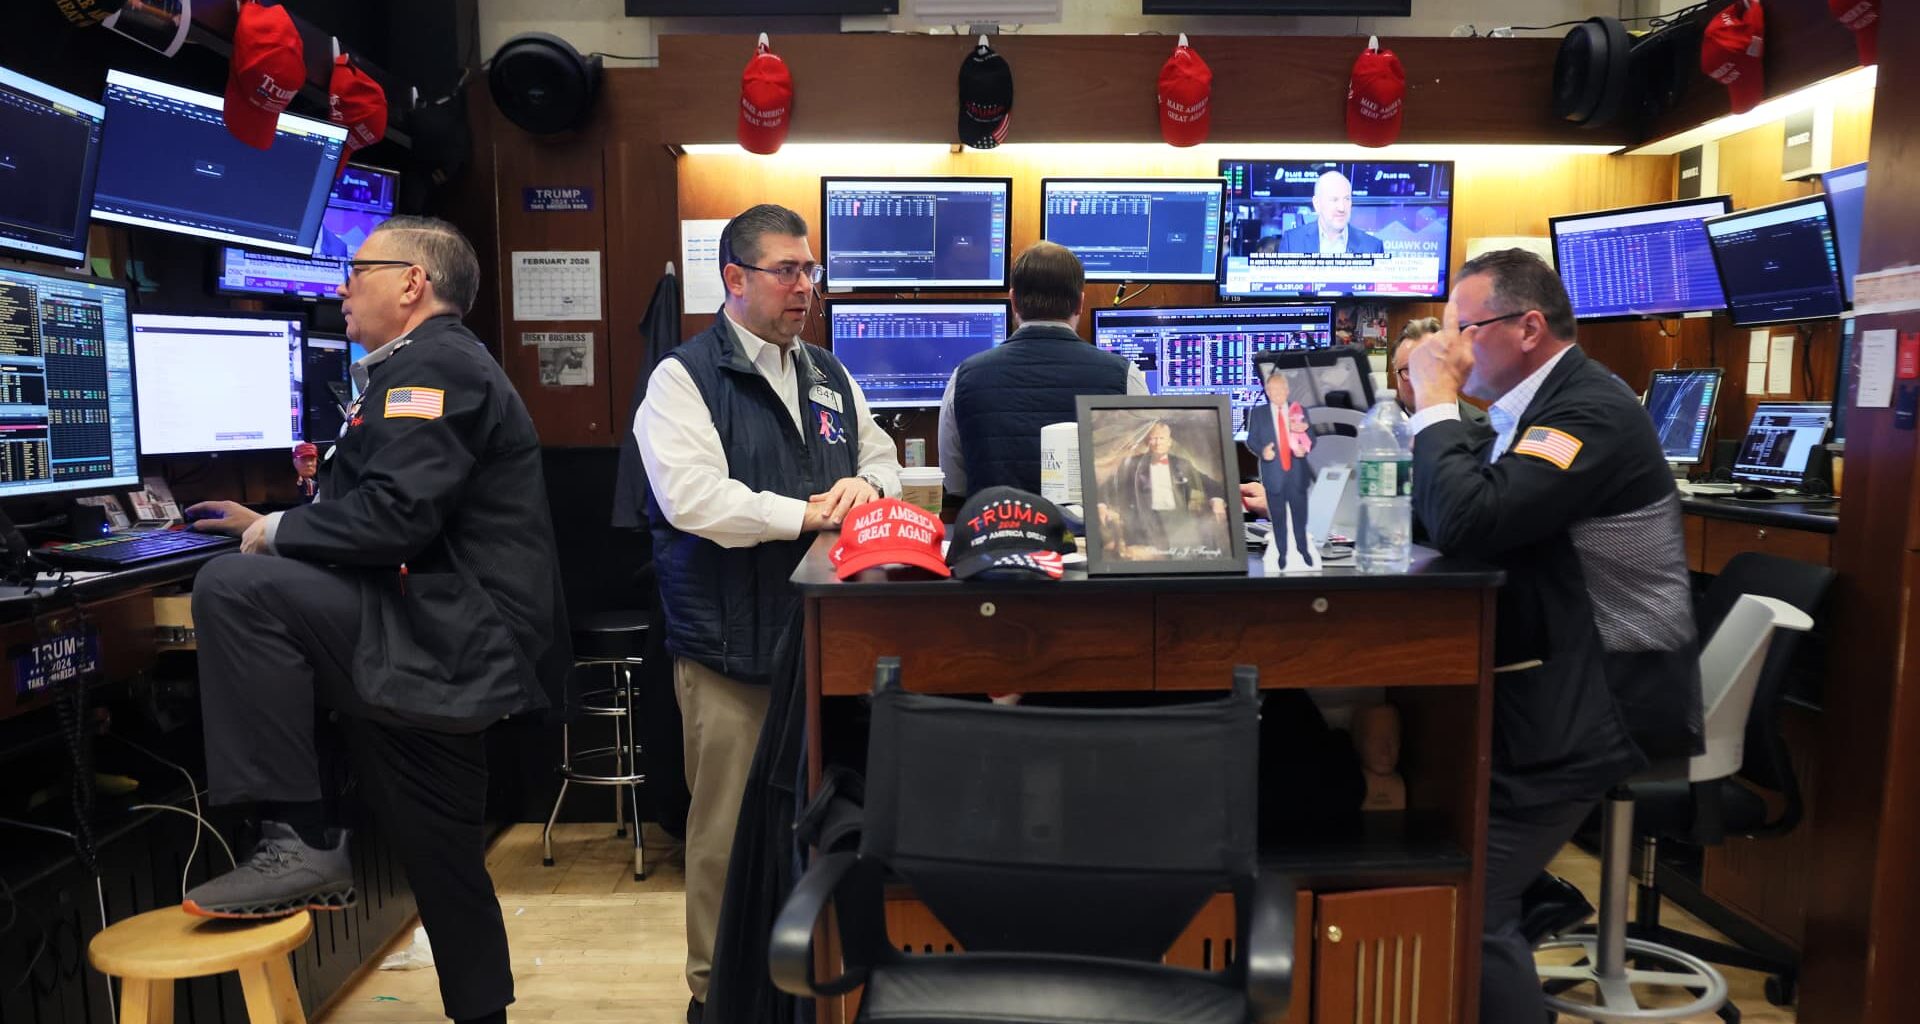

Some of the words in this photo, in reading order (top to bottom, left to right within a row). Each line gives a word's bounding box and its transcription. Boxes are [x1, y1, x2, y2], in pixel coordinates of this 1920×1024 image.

[535, 189, 581, 199] TRUMP
[1423, 241, 1438, 250] ON
[523, 333, 546, 341] RISKY
[548, 333, 586, 341] BUSINESS
[853, 507, 884, 532] MAKE
[889, 505, 937, 532] AMERICA
[967, 503, 1049, 532] TRUMP
[857, 522, 892, 544] GREAT
[897, 523, 932, 544] AGAIN
[989, 529, 1024, 540] AMERICA
